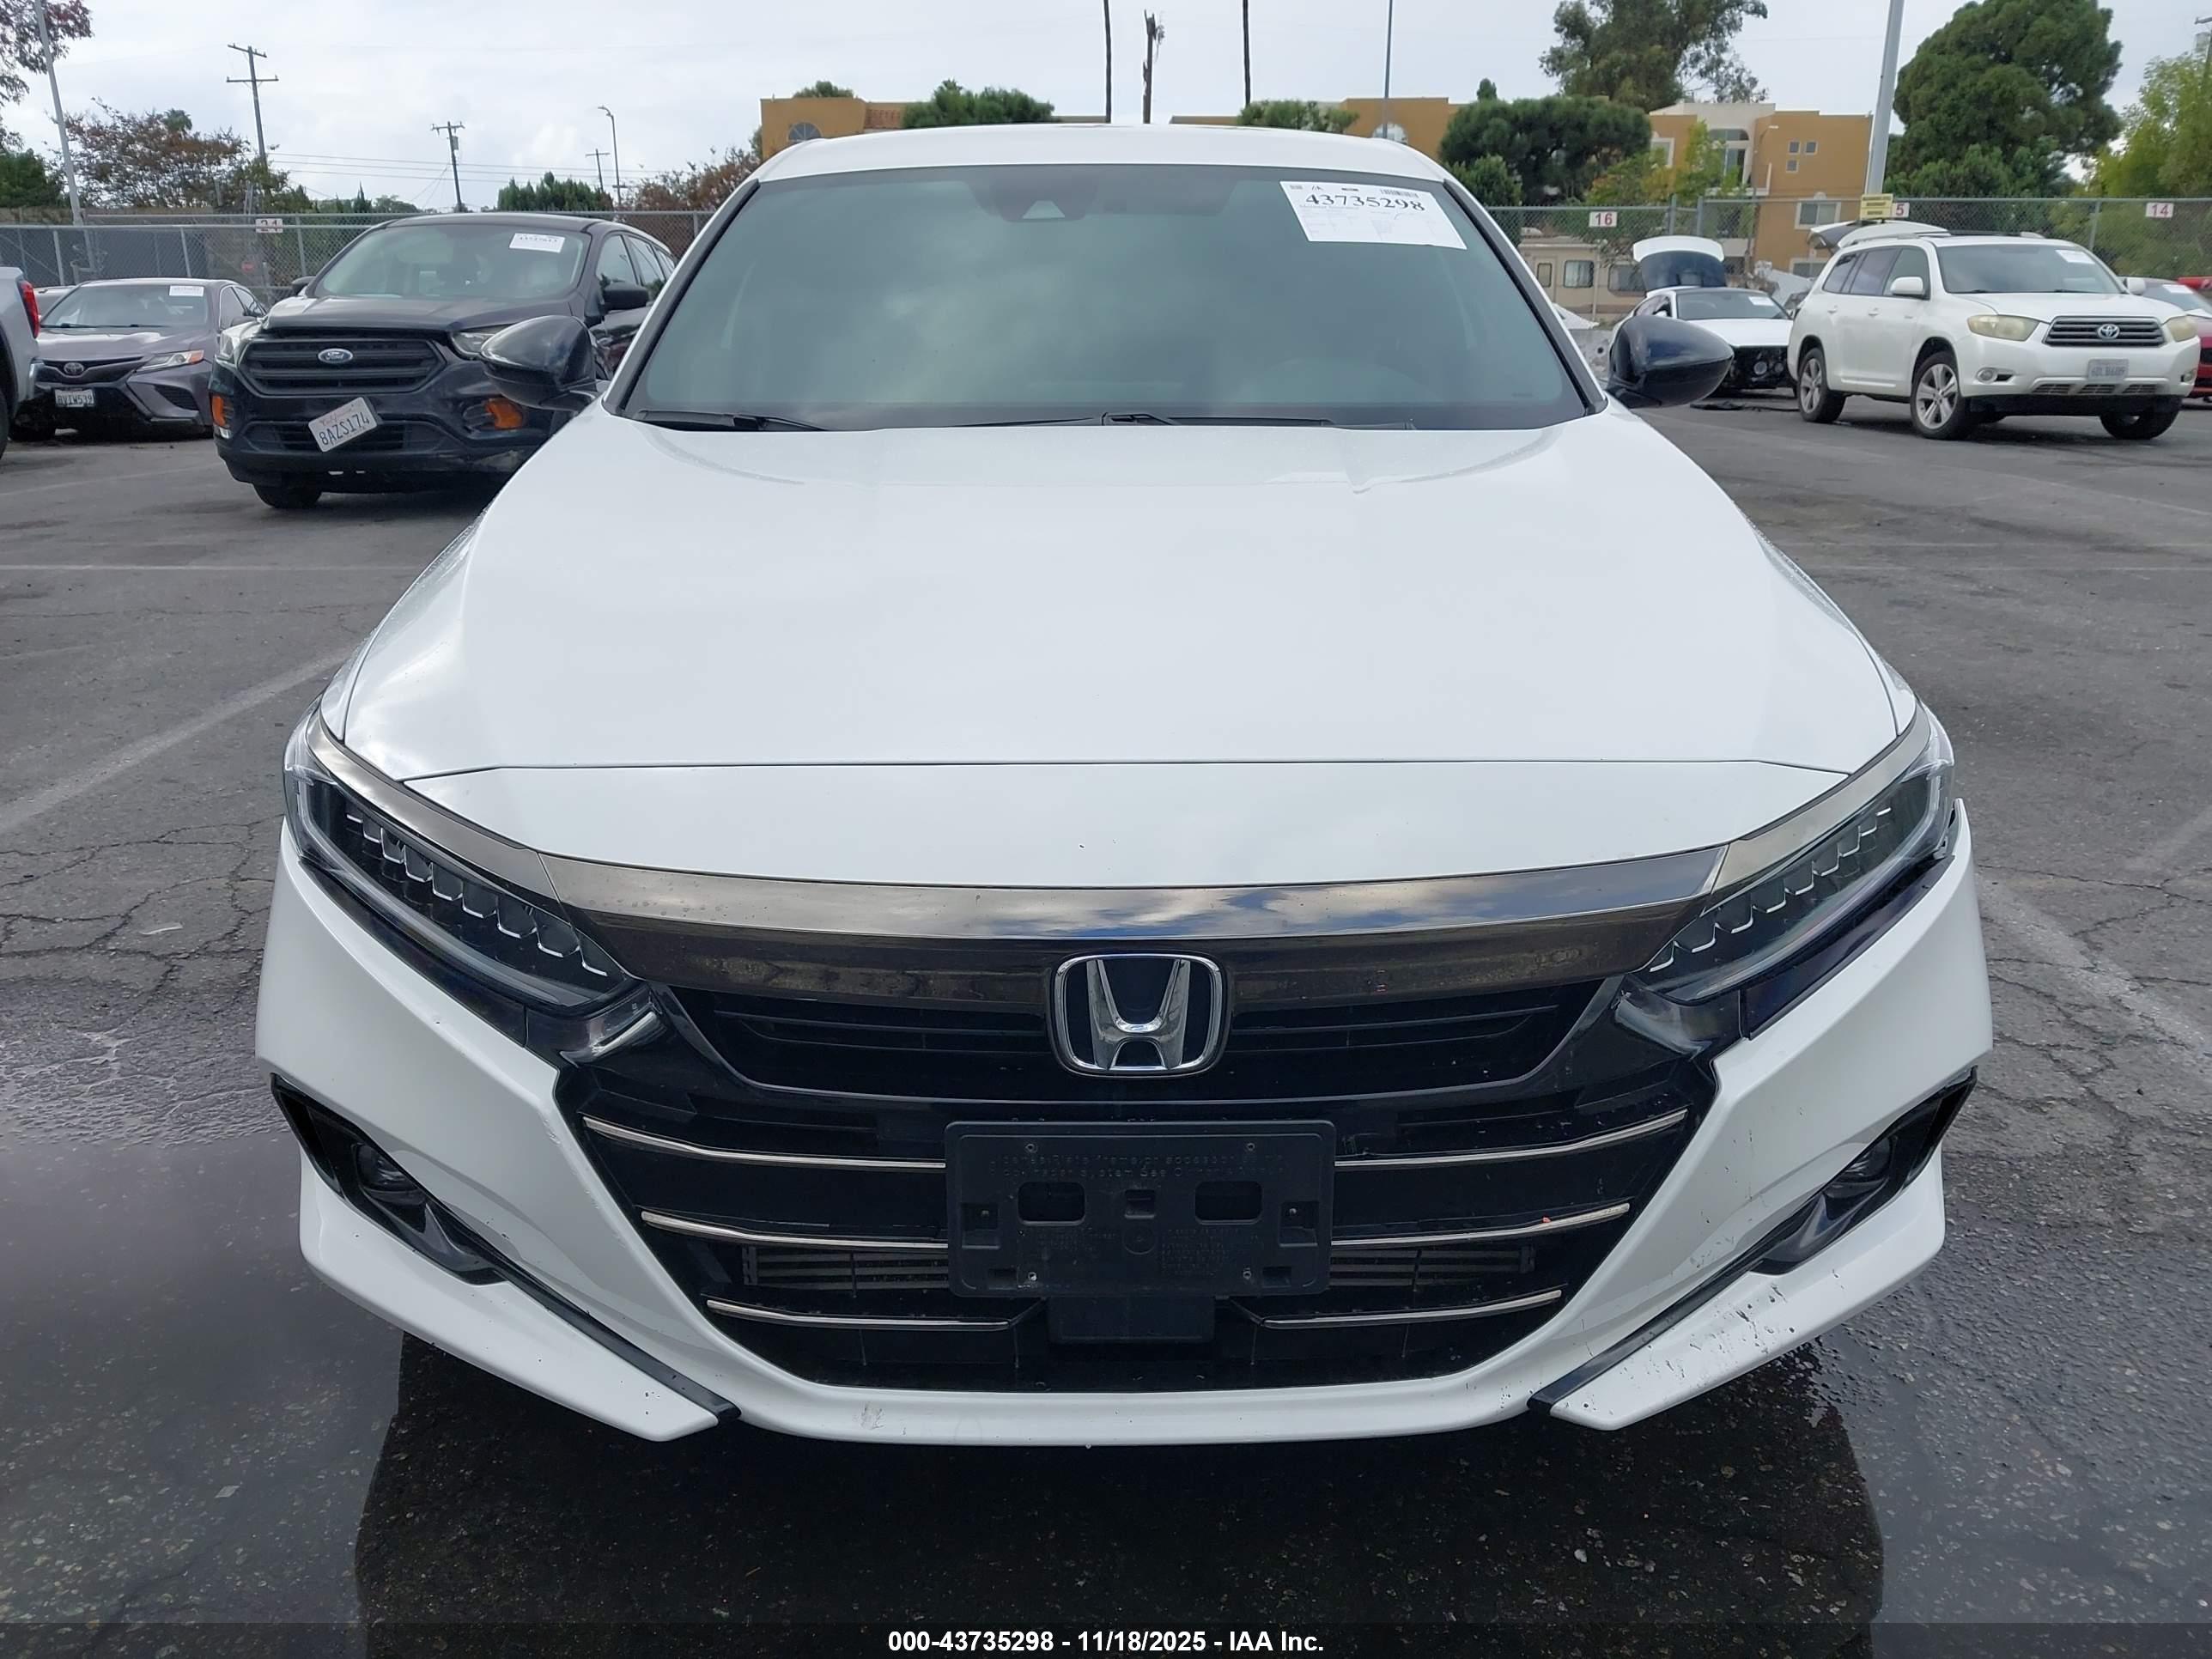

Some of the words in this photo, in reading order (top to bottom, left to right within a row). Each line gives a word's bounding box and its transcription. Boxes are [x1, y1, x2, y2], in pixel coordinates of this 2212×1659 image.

[1305, 194, 1425, 211] 43735298
[2152, 204, 2169, 217] 14
[1595, 212, 1613, 226] 16
[319, 411, 370, 446] 8AZS174
